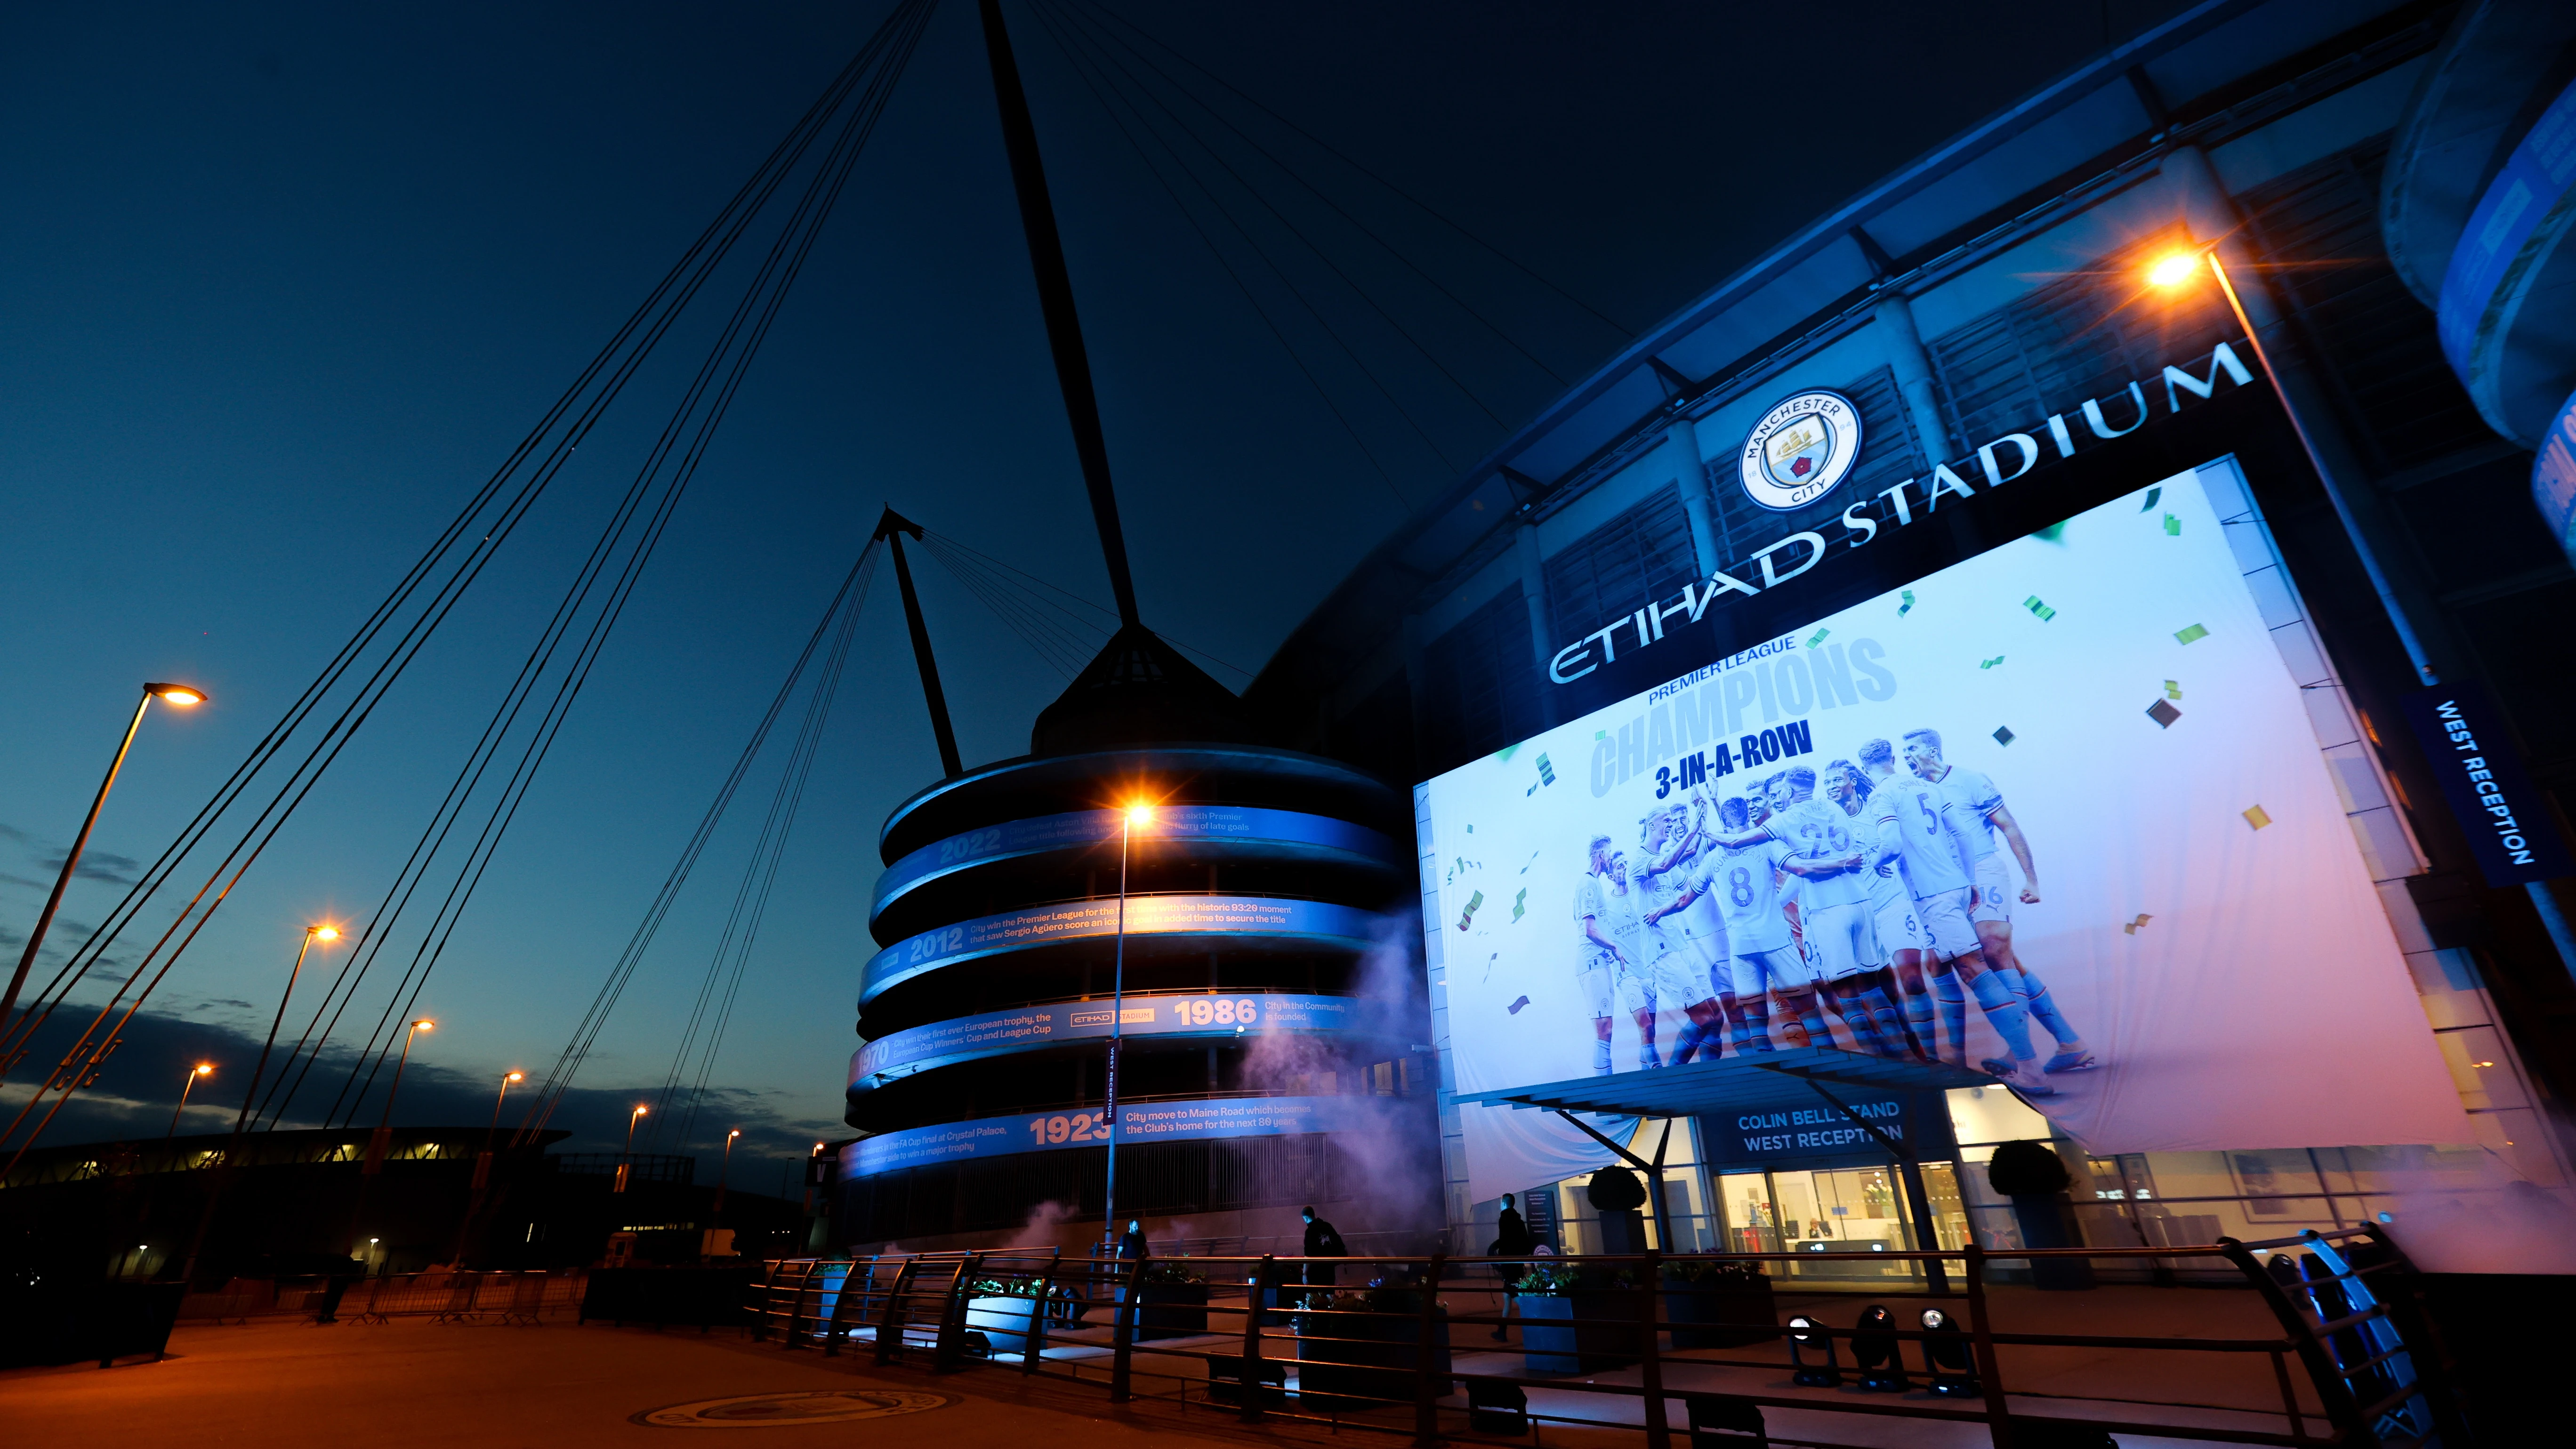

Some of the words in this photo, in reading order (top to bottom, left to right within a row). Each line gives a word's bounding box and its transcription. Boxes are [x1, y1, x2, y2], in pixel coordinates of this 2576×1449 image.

[1747, 398, 1841, 458] MANCHESTER
[1839, 421, 1852, 431] 94
[1747, 470, 1757, 479] 18
[1791, 479, 1827, 502] CITY
[1549, 531, 1826, 684] ETIHAD
[1843, 342, 2254, 547] STADIUM
[1649, 661, 1722, 706] PREMIER
[1725, 636, 1796, 670] LEAGUE
[1591, 637, 1897, 798] CHAMPIONS
[1656, 719, 1813, 800] 3-IN-A-ROW
[2435, 700, 2479, 751] WEST
[2462, 757, 2535, 865] RECEPTION
[1209, 813, 1243, 821] Premier
[1916, 793, 1938, 835] 5
[1009, 827, 1026, 836] City
[1054, 819, 1079, 829] Aston
[1056, 826, 1096, 837] following
[1228, 823, 1249, 831] goals
[1800, 813, 1850, 859] 26
[940, 829, 1001, 864] 2022
[1729, 867, 1755, 908] 8
[970, 924, 986, 934] City
[987, 922, 1001, 930] win
[1002, 918, 1015, 927] the
[1017, 914, 1051, 925] Premier
[1052, 910, 1084, 921] League
[1085, 908, 1099, 917] for
[1100, 907, 1115, 915] the
[1116, 905, 1135, 915] frst
[1159, 903, 1179, 911] with
[1181, 903, 1195, 911] the
[1197, 903, 1230, 912] historic
[1231, 904, 1257, 912] 93:20
[970, 934, 985, 944] that
[986, 932, 1004, 941] saw
[1004, 927, 1030, 937] Sergio
[1032, 923, 1063, 934] Agüero
[1064, 920, 1090, 929] score
[1091, 919, 1103, 927] an
[1133, 915, 1152, 925] goal
[1154, 915, 1162, 923] in
[1164, 914, 1192, 922] added
[1193, 914, 1214, 922] time
[1270, 915, 1286, 924] title
[1615, 921, 1640, 935] ETIHA
[910, 926, 963, 963] 2012
[1074, 1014, 1110, 1023] ETIHAD
[1174, 999, 1256, 1026] 1986
[1264, 1001, 1282, 1011] City
[1283, 1001, 1291, 1009] in
[1292, 1002, 1304, 1010] the
[1305, 1002, 1345, 1013] Community
[1274, 1013, 1306, 1021] founded
[933, 1029, 946, 1038] first
[948, 1026, 964, 1035] ever
[965, 1020, 1003, 1032] European
[1004, 1015, 1035, 1026] trophy,
[1036, 1014, 1051, 1022] the
[893, 1046, 920, 1058] European
[920, 1042, 934, 1052] Cup
[966, 1033, 982, 1043] Cup
[983, 1030, 998, 1040] and
[1000, 1028, 1031, 1038] League
[1033, 1025, 1051, 1035] Cup
[859, 1040, 889, 1074] 1970
[1126, 1111, 1146, 1123] City
[1148, 1111, 1175, 1120] move
[1176, 1110, 1187, 1119] to
[1189, 1108, 1219, 1118] Maine
[1220, 1106, 1244, 1116] Road
[1246, 1105, 1273, 1114] which
[1274, 1105, 1311, 1113] becomes
[1126, 1125, 1143, 1135] the
[1144, 1122, 1174, 1133] Club's
[1175, 1122, 1203, 1131] home
[1205, 1120, 1218, 1130] for
[1219, 1119, 1234, 1128] the
[1236, 1119, 1257, 1128] next
[1258, 1117, 1271, 1127] 80
[1273, 1118, 1297, 1128] years
[1738, 1112, 1787, 1130] COLIN
[1791, 1108, 1835, 1126] BELL
[900, 1139, 907, 1148] FA
[908, 1137, 921, 1147] Cup
[922, 1134, 937, 1145] final
[938, 1134, 946, 1142] at
[947, 1128, 975, 1142] Crystal
[1030, 1112, 1110, 1145] 1923
[900, 1152, 907, 1160] to
[907, 1149, 919, 1159] win
[926, 1145, 947, 1157] major
[948, 1142, 975, 1153] trophy
[1743, 1135, 1792, 1151] WEST
